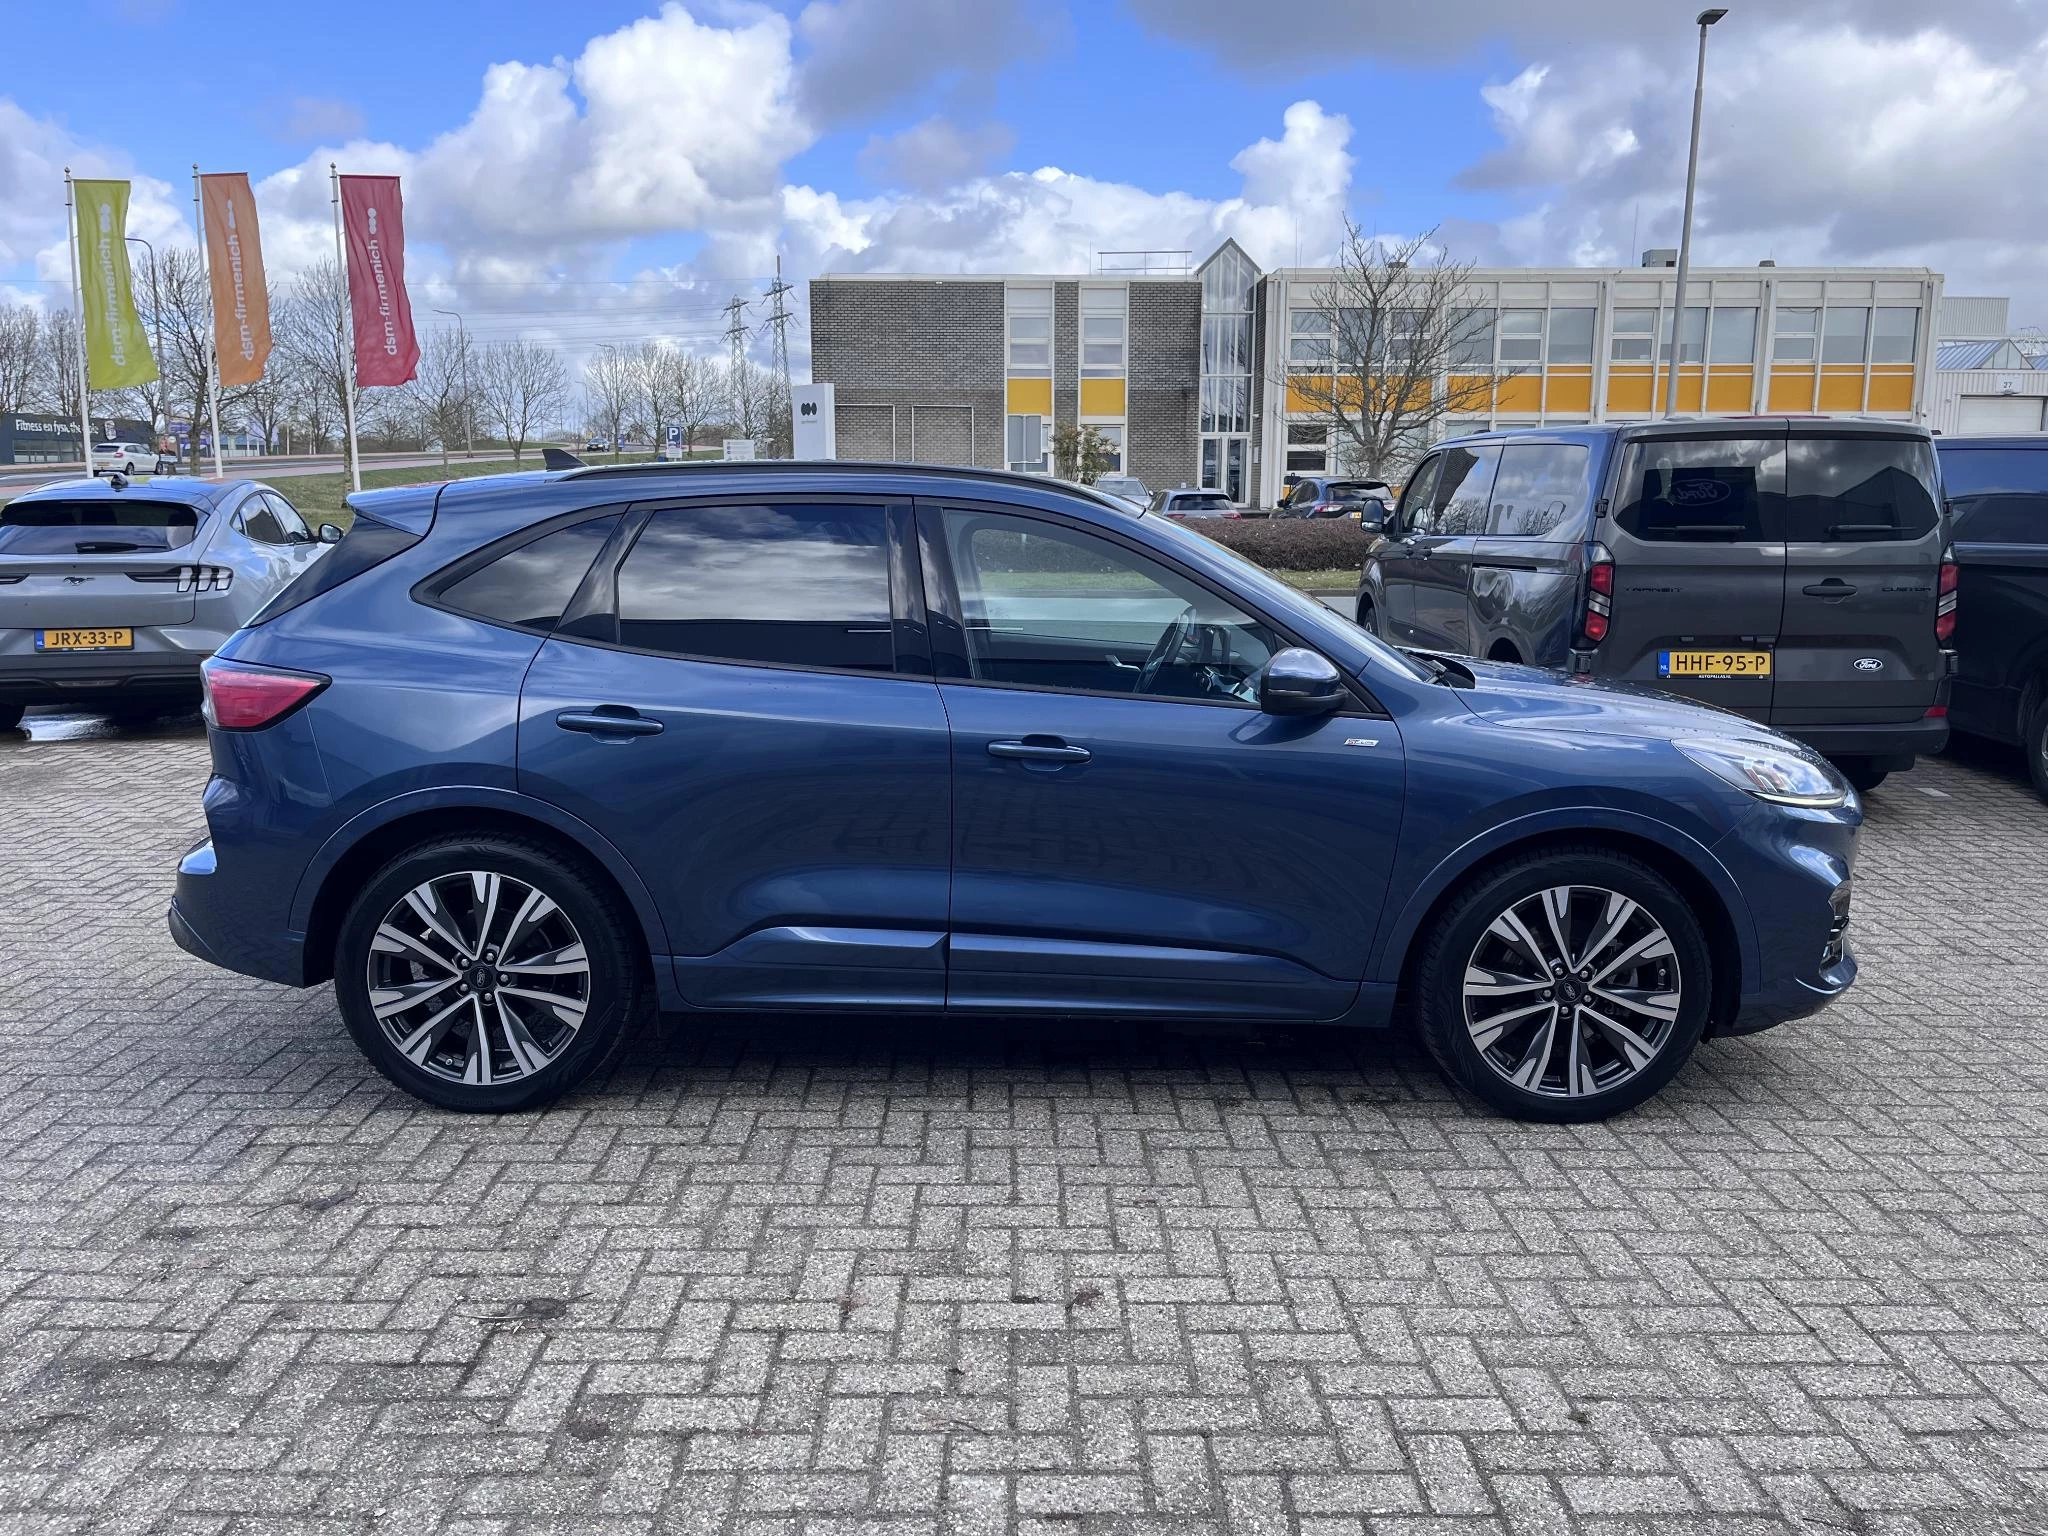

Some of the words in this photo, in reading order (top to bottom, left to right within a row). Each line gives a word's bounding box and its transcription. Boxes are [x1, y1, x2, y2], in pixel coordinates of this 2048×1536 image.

[98, 237, 126, 368] dsm-firmenich
[227, 234, 255, 361] dsm-firmenich
[367, 239, 398, 356] dsm-firmenich
[15, 419, 43, 432] Fitness
[668, 427, 679, 440] P
[51, 631, 123, 646] JRX-33-P
[1676, 654, 1766, 672] HHF-95-P
